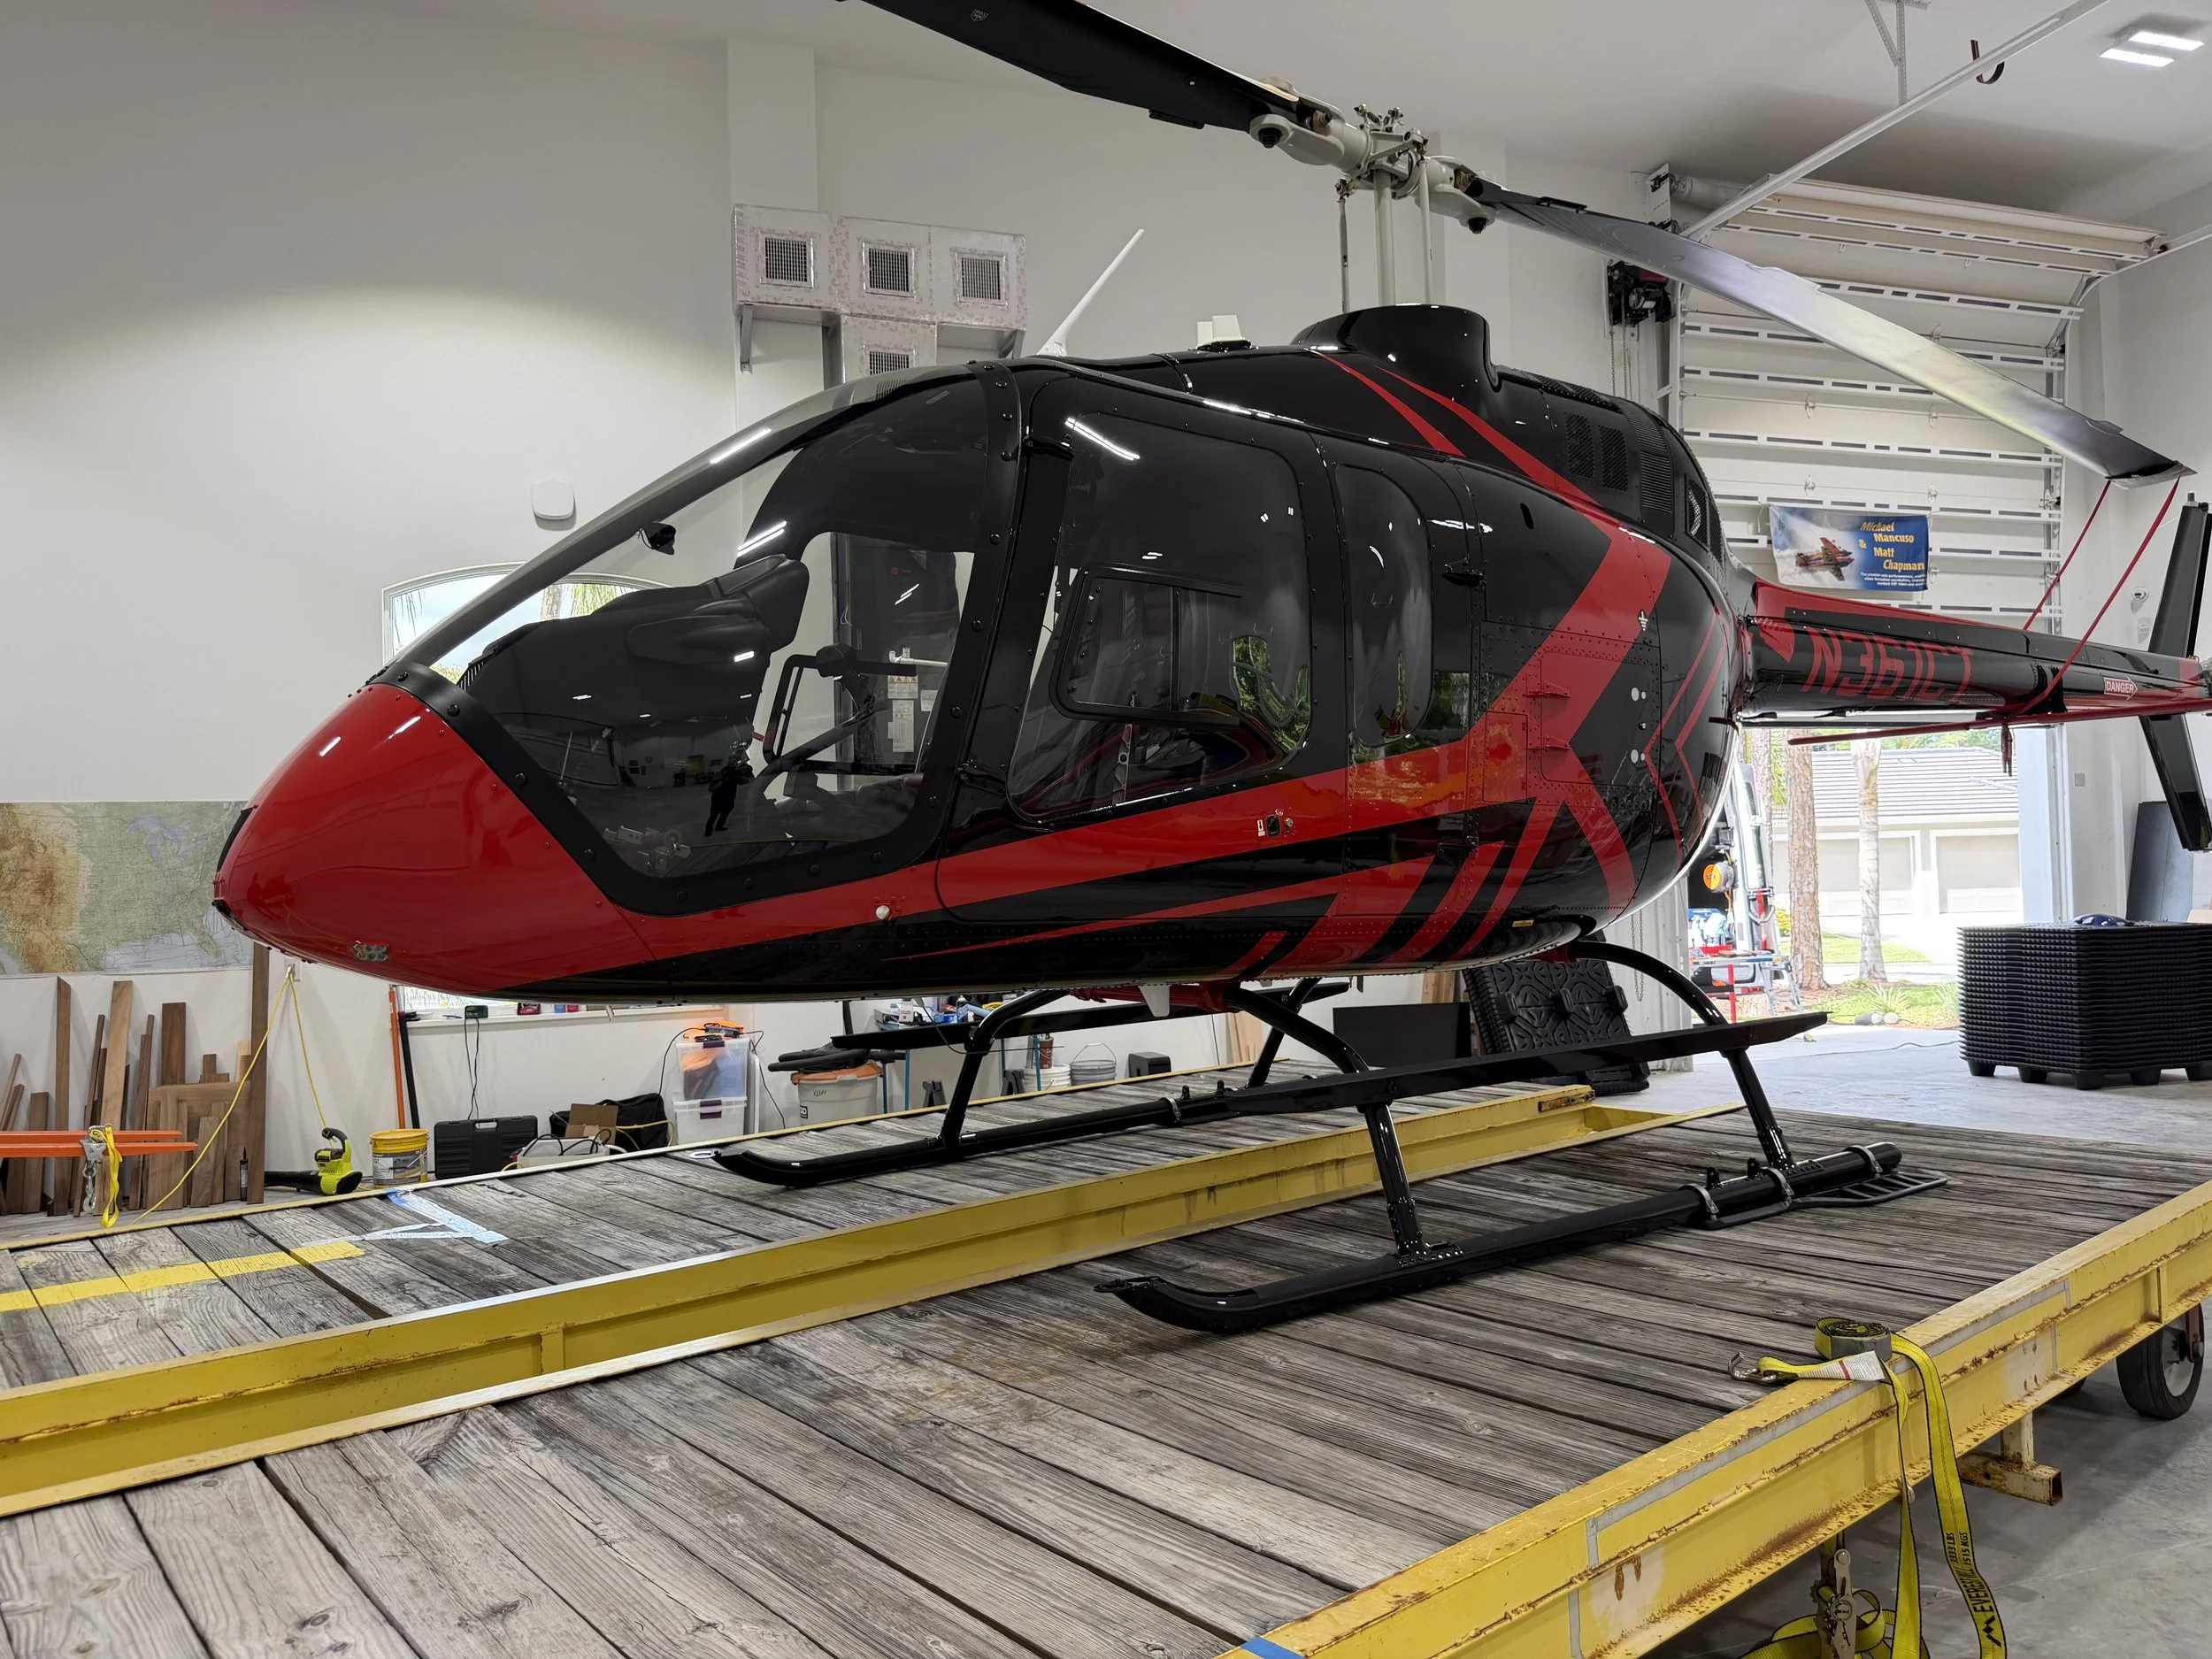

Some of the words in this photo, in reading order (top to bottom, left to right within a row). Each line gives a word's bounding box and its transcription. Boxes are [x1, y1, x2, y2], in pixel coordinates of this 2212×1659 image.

[1860, 522, 1895, 532] Michael
[1858, 539, 1867, 549] &
[1873, 533, 1915, 543] Mancuso
[1873, 547, 1895, 557] Matt
[1883, 559, 1925, 572] Chapman
[1800, 626, 1975, 704] N361CT
[2106, 680, 2134, 694] DANGER
[1947, 1532, 1955, 1546] LBS
[1959, 1532, 1970, 1547] KGS
[1948, 1546, 1958, 1564] 3333
[1961, 1548, 1972, 1565] 1515
